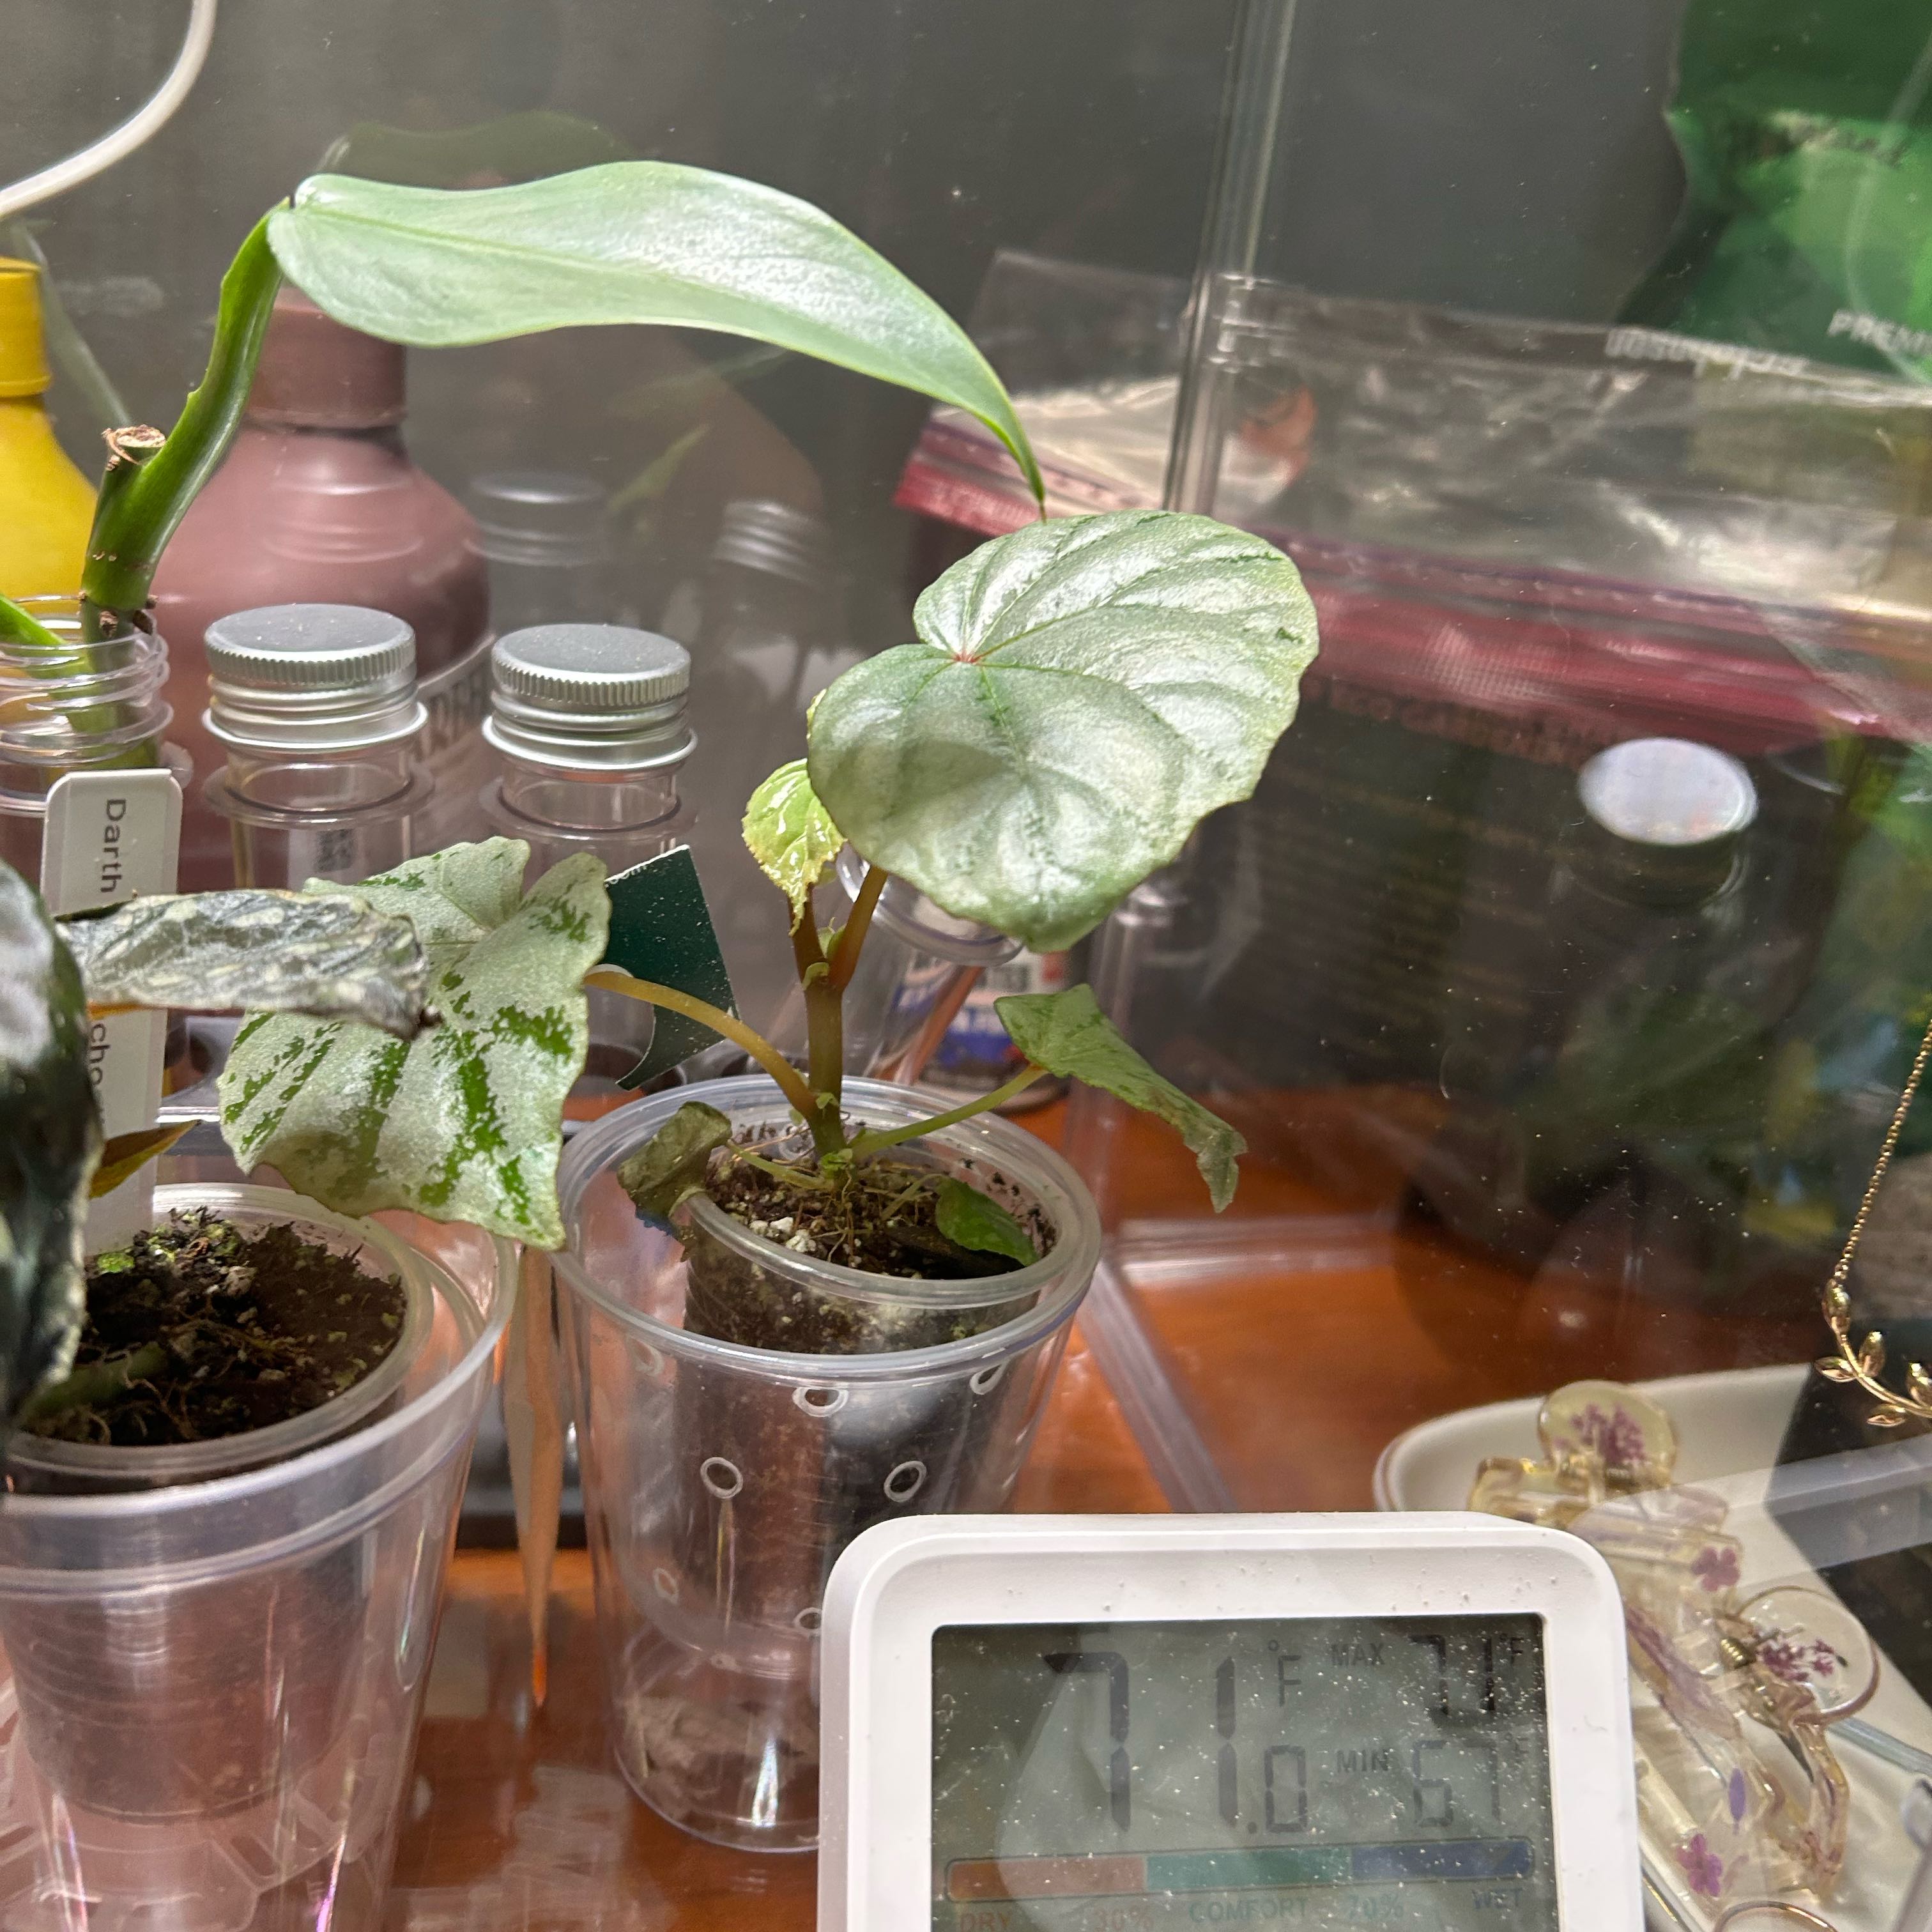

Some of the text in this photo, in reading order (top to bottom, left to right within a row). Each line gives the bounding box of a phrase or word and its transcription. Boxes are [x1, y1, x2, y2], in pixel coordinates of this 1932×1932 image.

[100, 799, 126, 893] Darth
[1331, 1643, 1385, 1666] MAX
[1337, 1749, 1390, 1772] MIN
[960, 1911, 1011, 1932] DRY
[1188, 1897, 1308, 1924] COMFORT
[1471, 1888, 1524, 1911] WET
